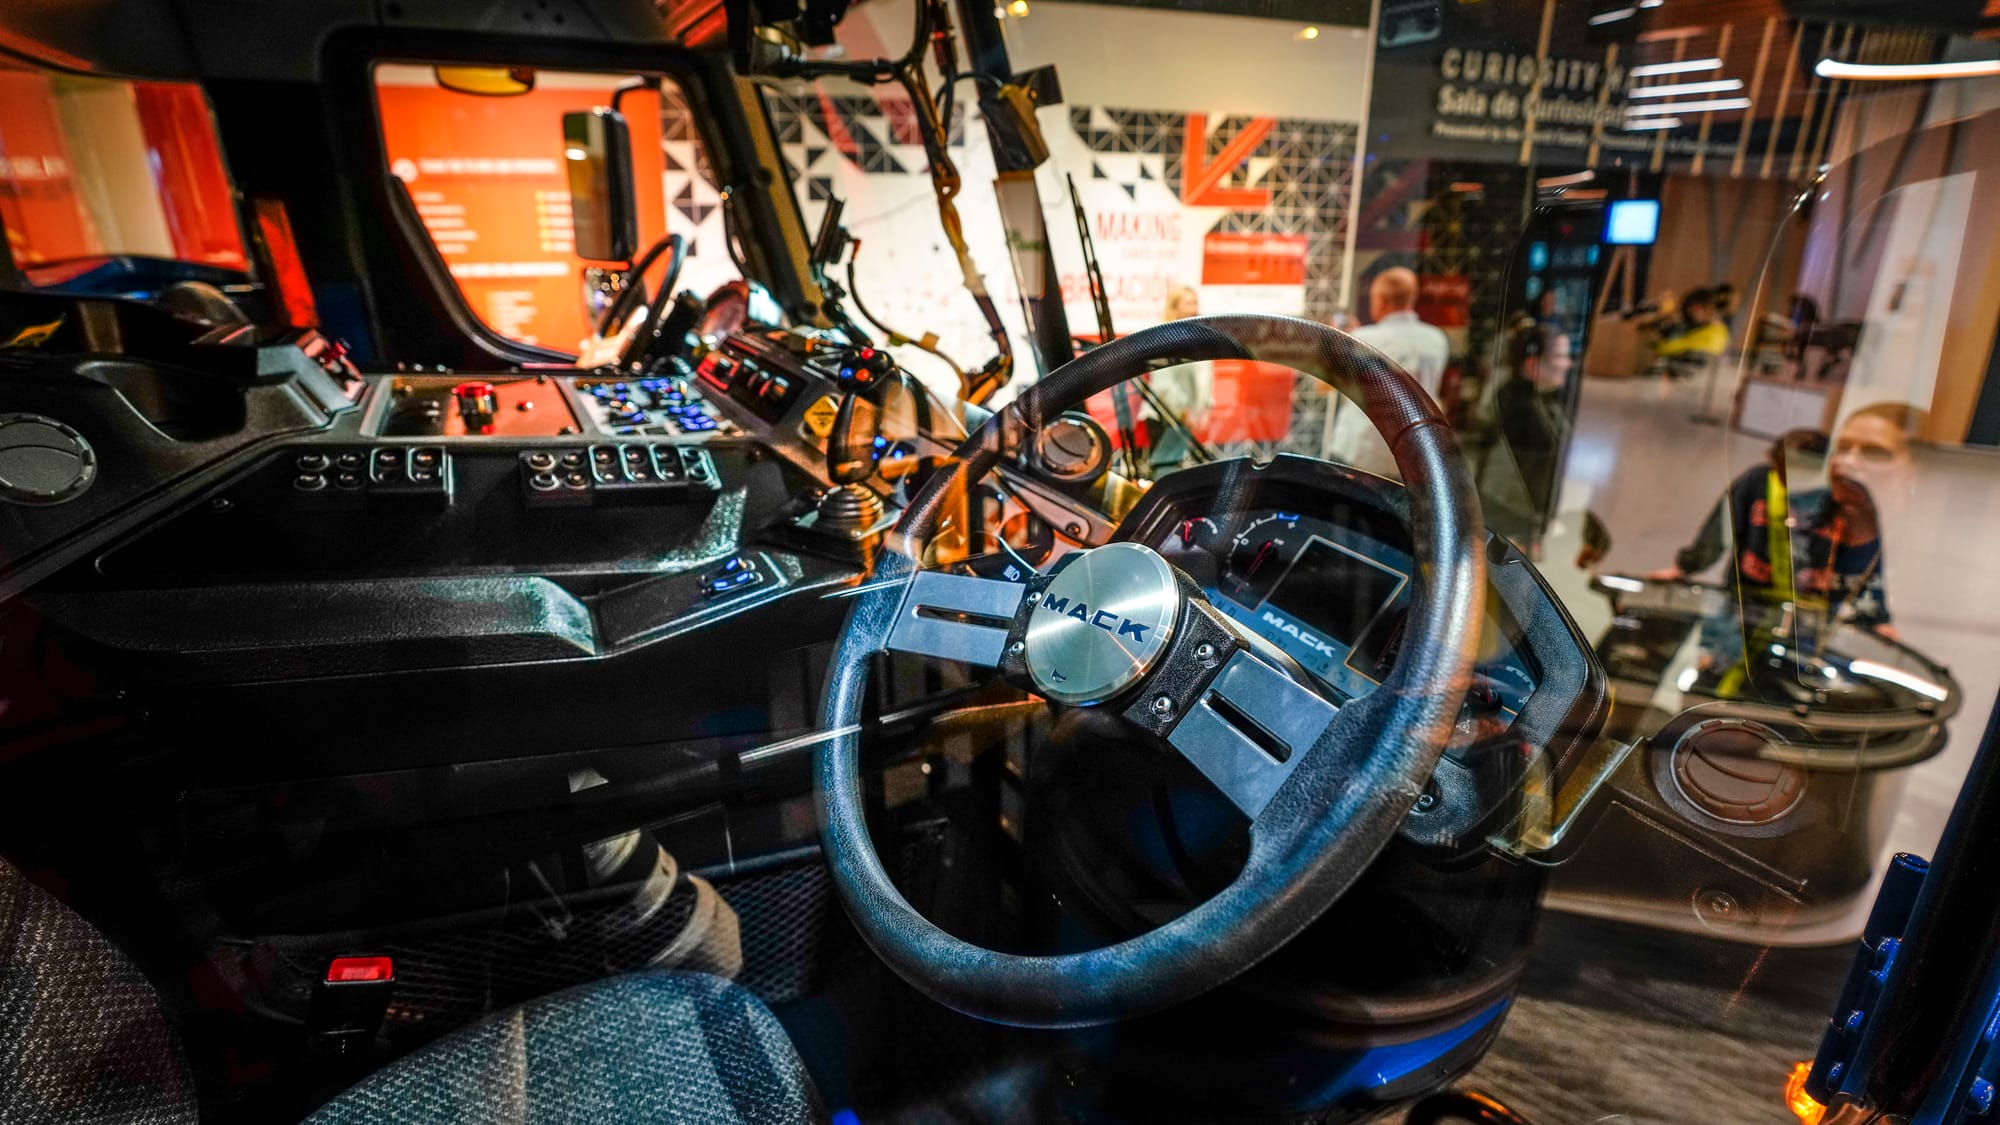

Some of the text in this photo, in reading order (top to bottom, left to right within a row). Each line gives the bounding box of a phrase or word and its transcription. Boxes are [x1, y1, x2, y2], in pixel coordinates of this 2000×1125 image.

[1441, 48, 1600, 91] CURIOSITY
[1437, 84, 1488, 117] Sala
[1490, 91, 1520, 120] de
[1097, 212, 1182, 242] MAKING
[1041, 593, 1151, 643] MACK
[1262, 611, 1337, 658] MACK
